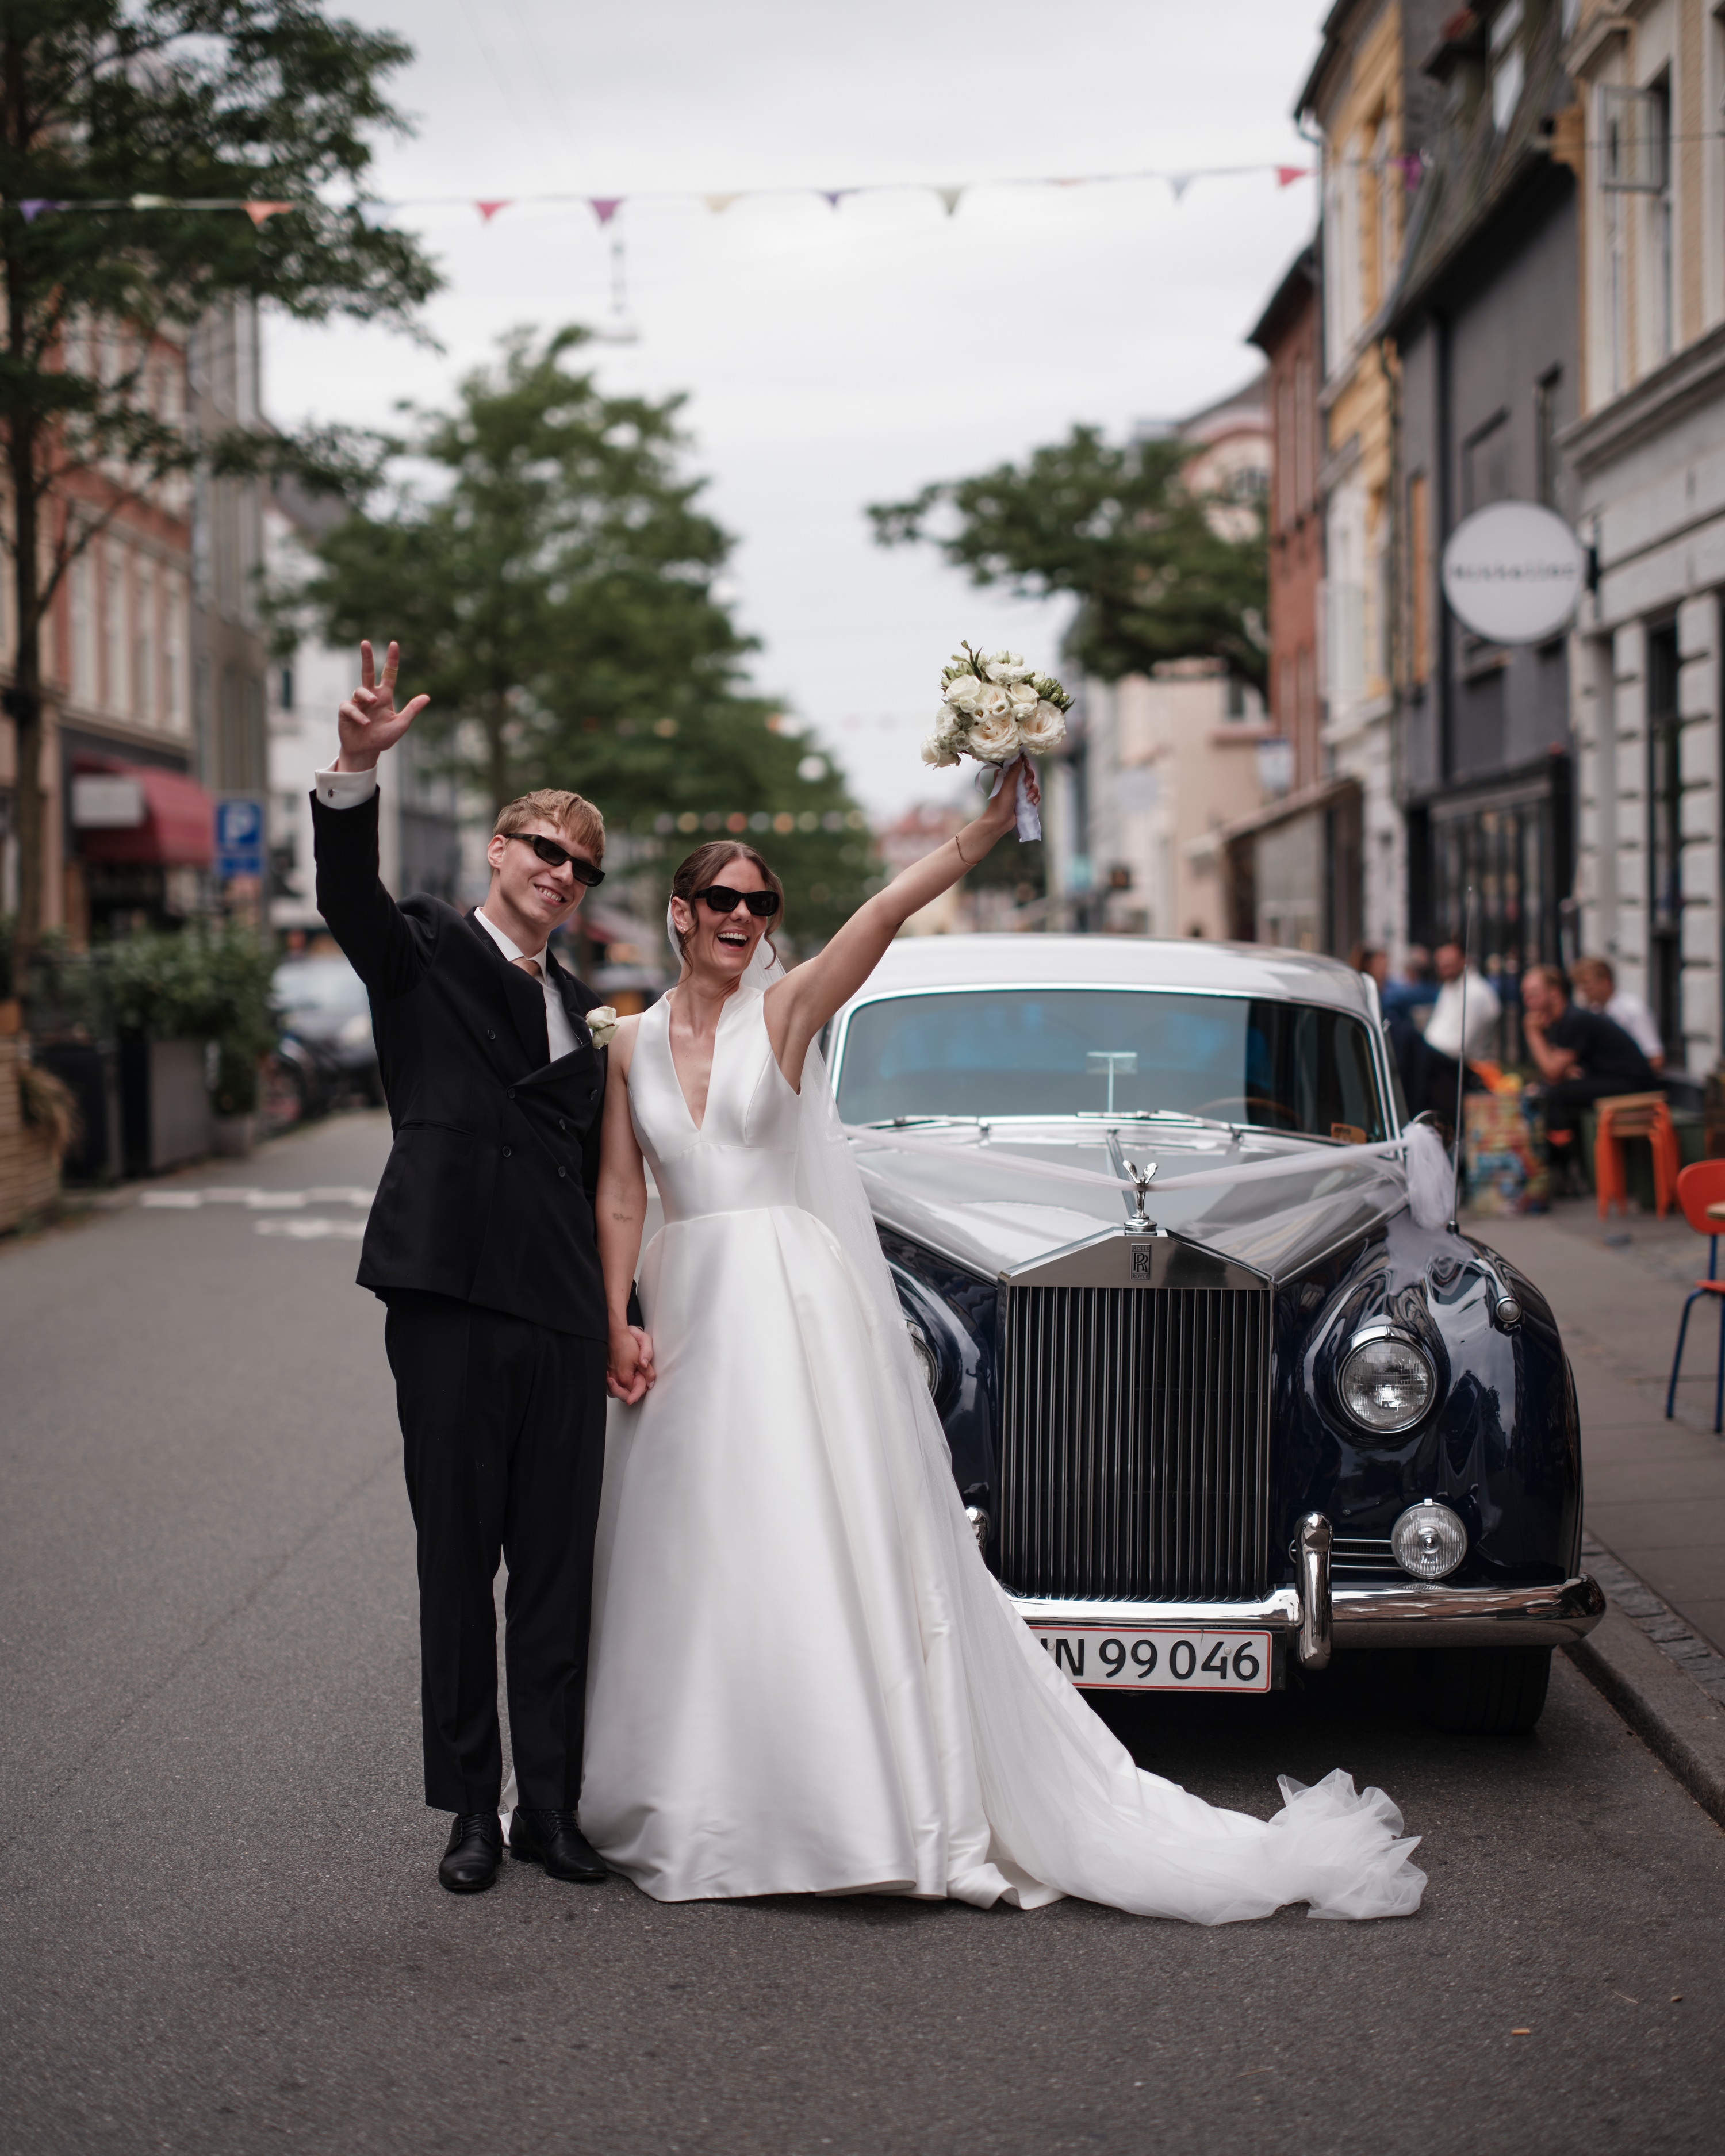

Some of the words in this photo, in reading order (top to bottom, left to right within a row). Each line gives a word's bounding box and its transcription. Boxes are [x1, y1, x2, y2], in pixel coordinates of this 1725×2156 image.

[224, 803, 256, 850] P
[1040, 1638, 1084, 1676] N
[1099, 1638, 1157, 1678] 99
[1169, 1640, 1259, 1681] 046
